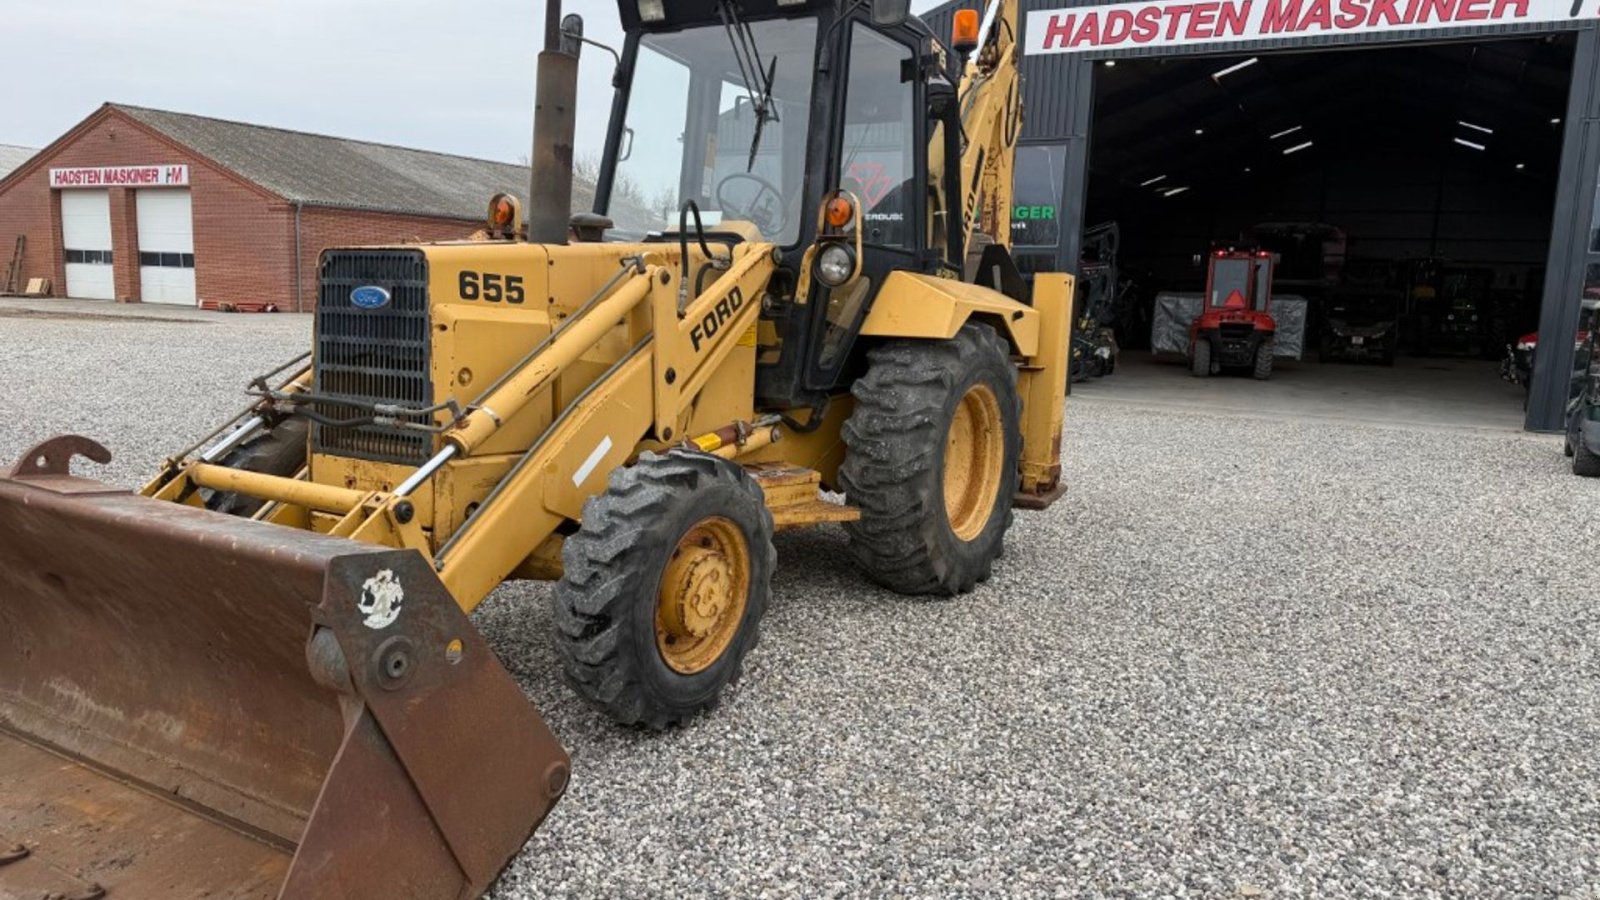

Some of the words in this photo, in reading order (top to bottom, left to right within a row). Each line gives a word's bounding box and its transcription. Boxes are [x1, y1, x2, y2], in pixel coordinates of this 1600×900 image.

[1042, 0, 1251, 49] HADSTEN
[54, 170, 100, 184] HADSTEN
[103, 168, 159, 183] MASKINER
[459, 270, 525, 304] 655
[690, 286, 743, 353] FORD
